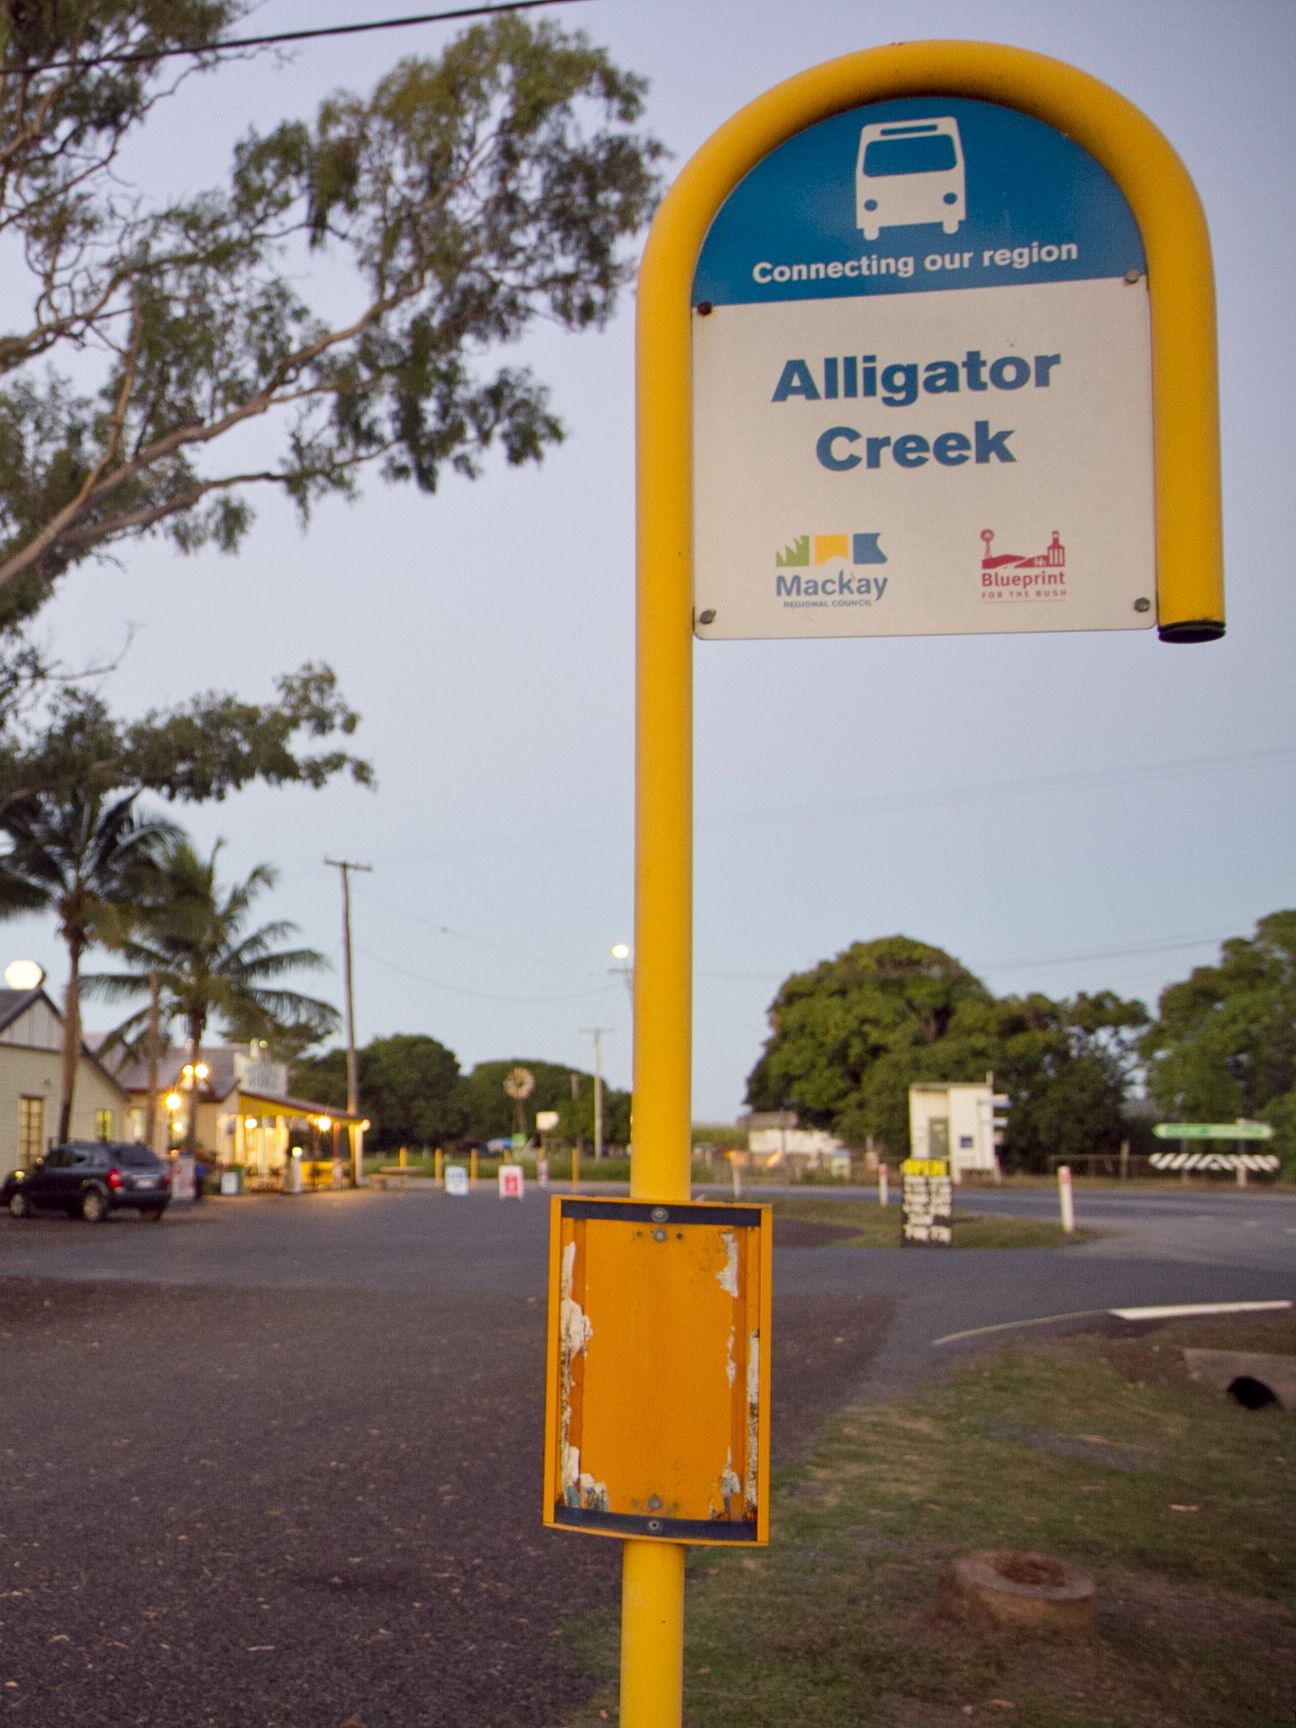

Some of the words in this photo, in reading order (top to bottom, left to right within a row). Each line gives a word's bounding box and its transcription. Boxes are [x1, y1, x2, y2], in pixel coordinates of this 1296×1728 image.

[752, 254, 915, 284] Connecting
[924, 250, 974, 271] our
[982, 241, 1078, 269] region
[770, 350, 1061, 407] Alligator
[816, 420, 1017, 471] Creek
[776, 569, 888, 602] Mackay
[981, 571, 1066, 589] Blueprint
[982, 591, 1003, 599] FOR
[1009, 590, 1030, 598] THE
[1035, 589, 1067, 598] BUSH
[783, 600, 828, 608] REGIONAL
[831, 599, 872, 607] COUNCIL
